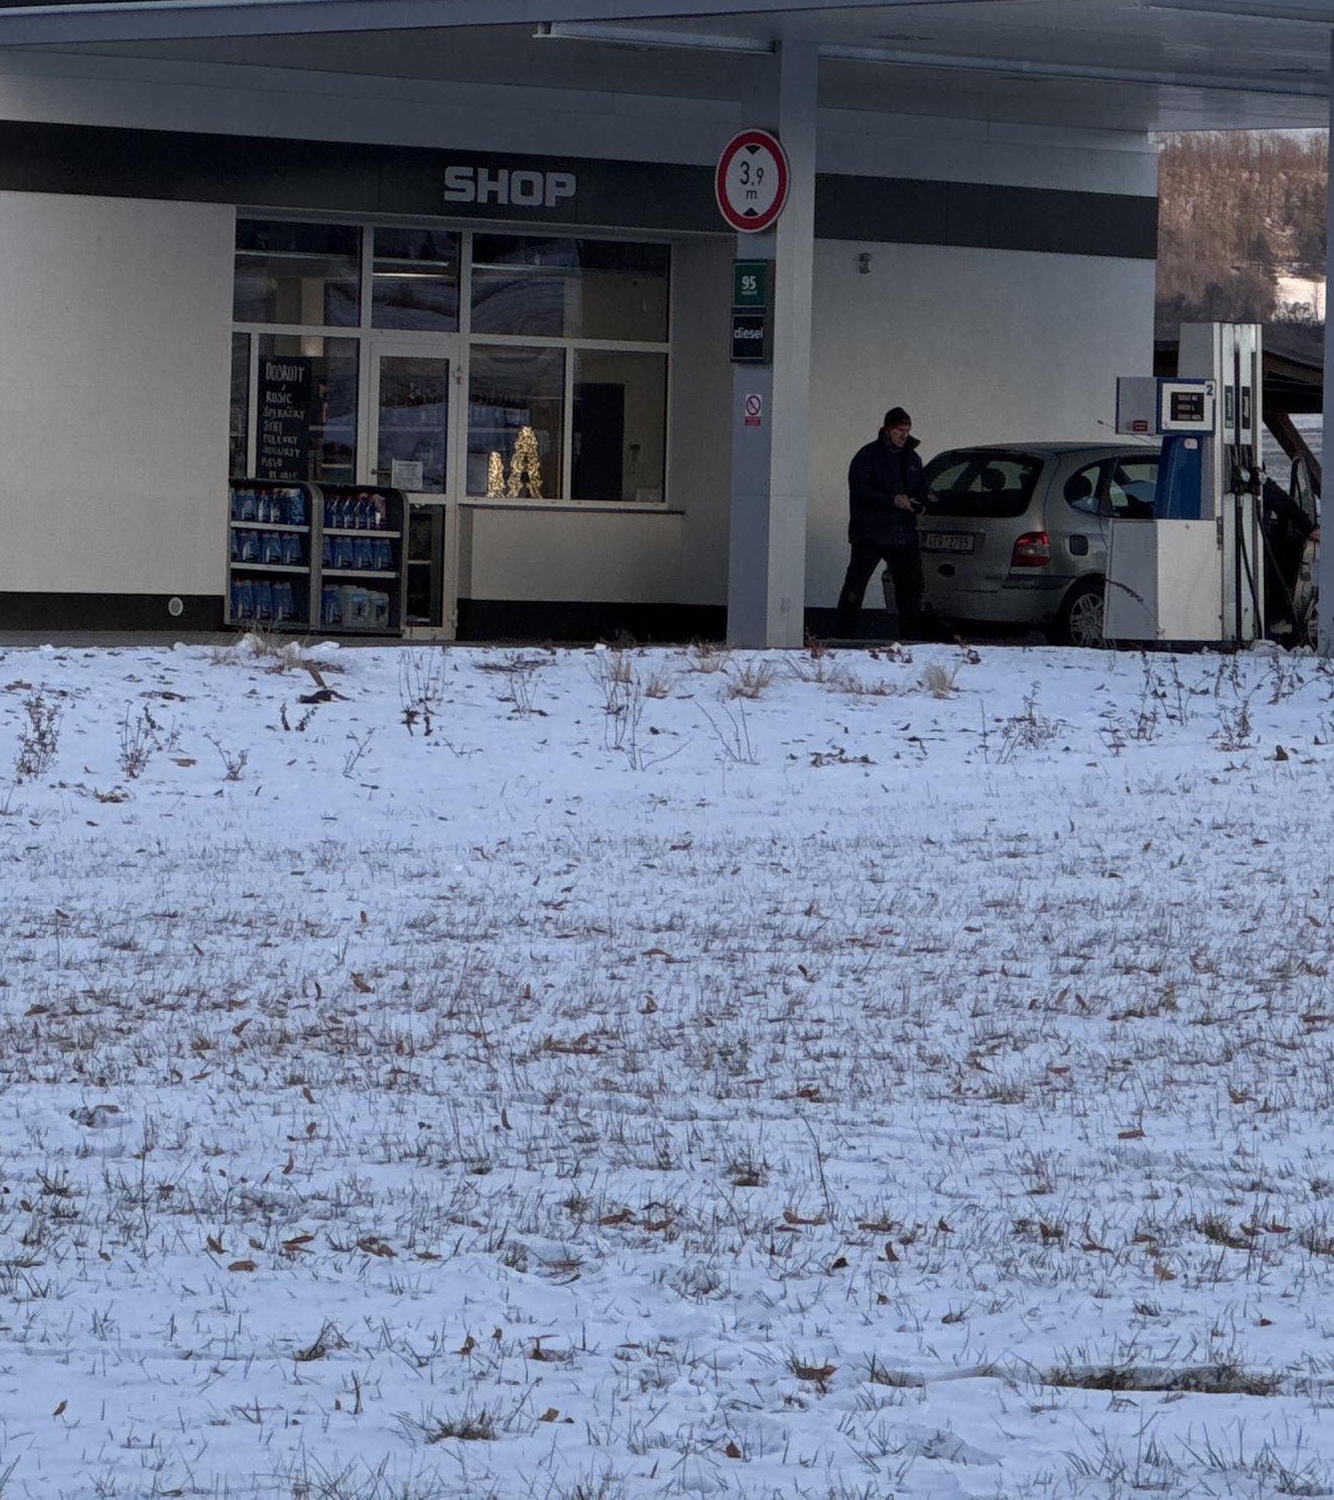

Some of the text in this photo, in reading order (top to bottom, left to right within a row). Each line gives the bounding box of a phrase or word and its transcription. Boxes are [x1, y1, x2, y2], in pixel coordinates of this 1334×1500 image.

[443, 165, 578, 208] SHOP
[746, 190, 758, 201] m
[741, 275, 757, 290] 95
[734, 327, 764, 340] diesel
[1206, 384, 1213, 396] 2
